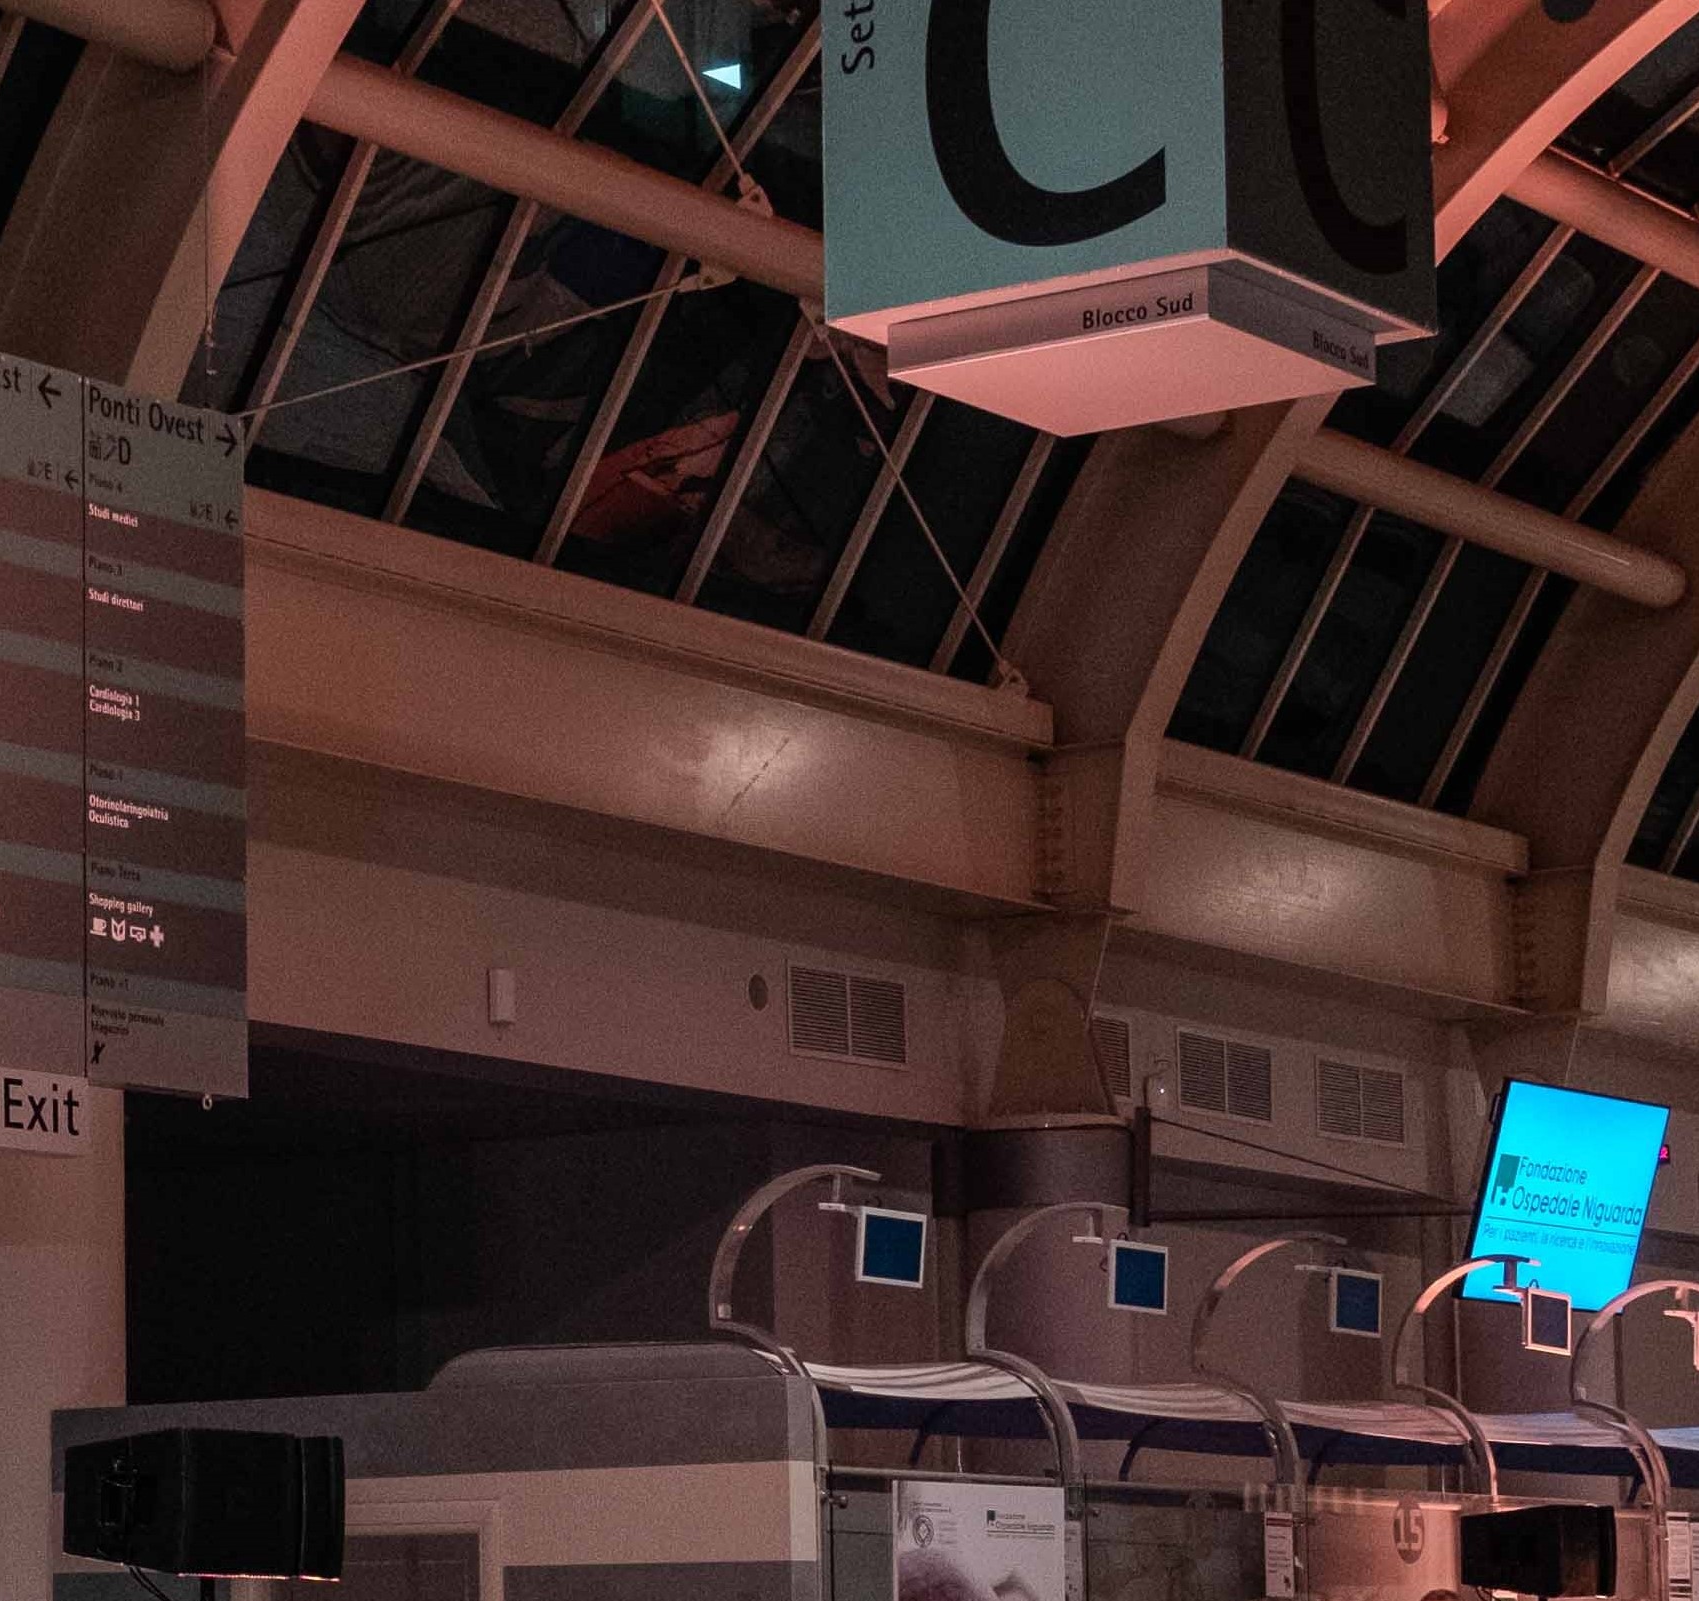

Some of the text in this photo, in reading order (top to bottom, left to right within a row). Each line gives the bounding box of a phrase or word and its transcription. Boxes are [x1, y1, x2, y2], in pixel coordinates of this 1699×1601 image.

[1082, 293, 1194, 331] Blocco Sud
[1312, 329, 1370, 371] Blocco Sud
[88, 385, 204, 444] Ponti Ovest
[119, 438, 131, 466] D
[88, 503, 138, 529] Studi medici
[88, 588, 110, 606] Studi
[89, 794, 169, 822] Otorinolaringoiatria
[89, 810, 130, 829] Oculistica
[89, 893, 154, 918] Shopping gallery
[4, 1078, 80, 1137] Exit
[1519, 1156, 1588, 1185] Fondazione
[1511, 1186, 1644, 1227] Ospedale Niguarda
